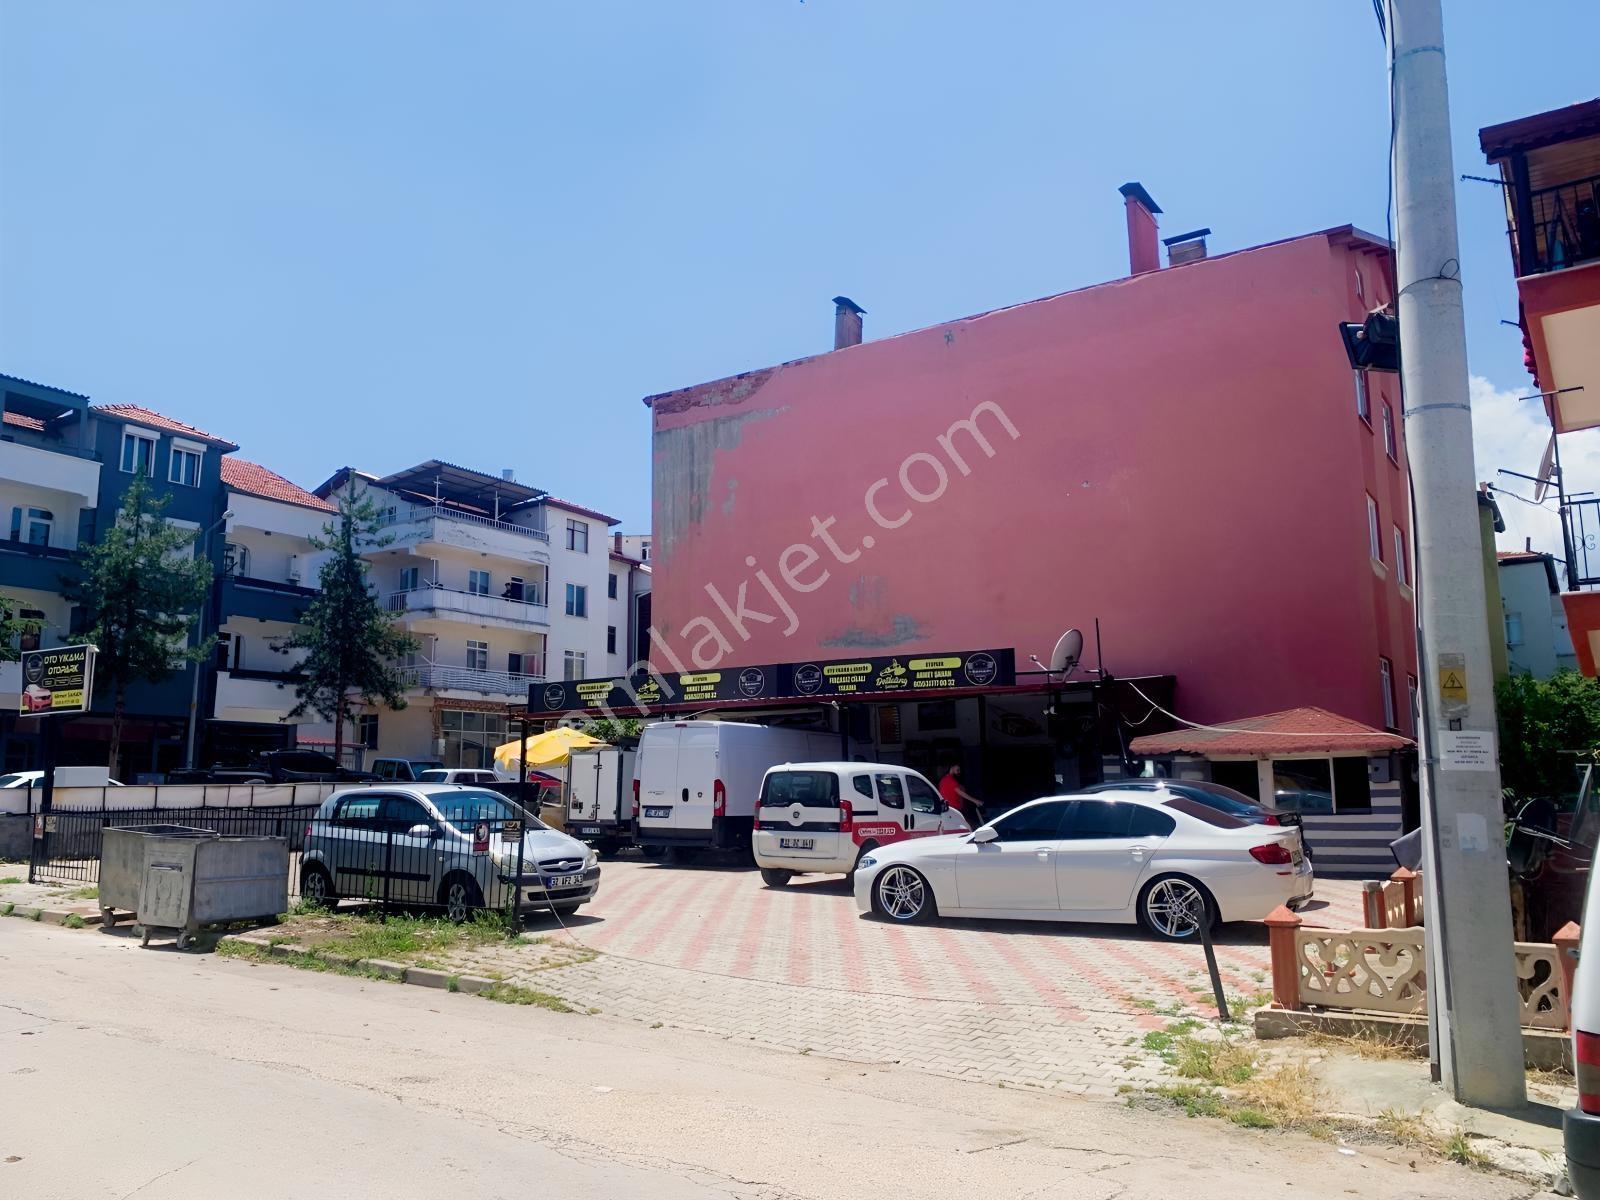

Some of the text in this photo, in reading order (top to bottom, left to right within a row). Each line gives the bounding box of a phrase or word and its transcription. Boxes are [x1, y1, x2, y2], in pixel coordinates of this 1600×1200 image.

[44, 652, 85, 664] OTO YIKAMA
[48, 664, 79, 675] OTOPARK
